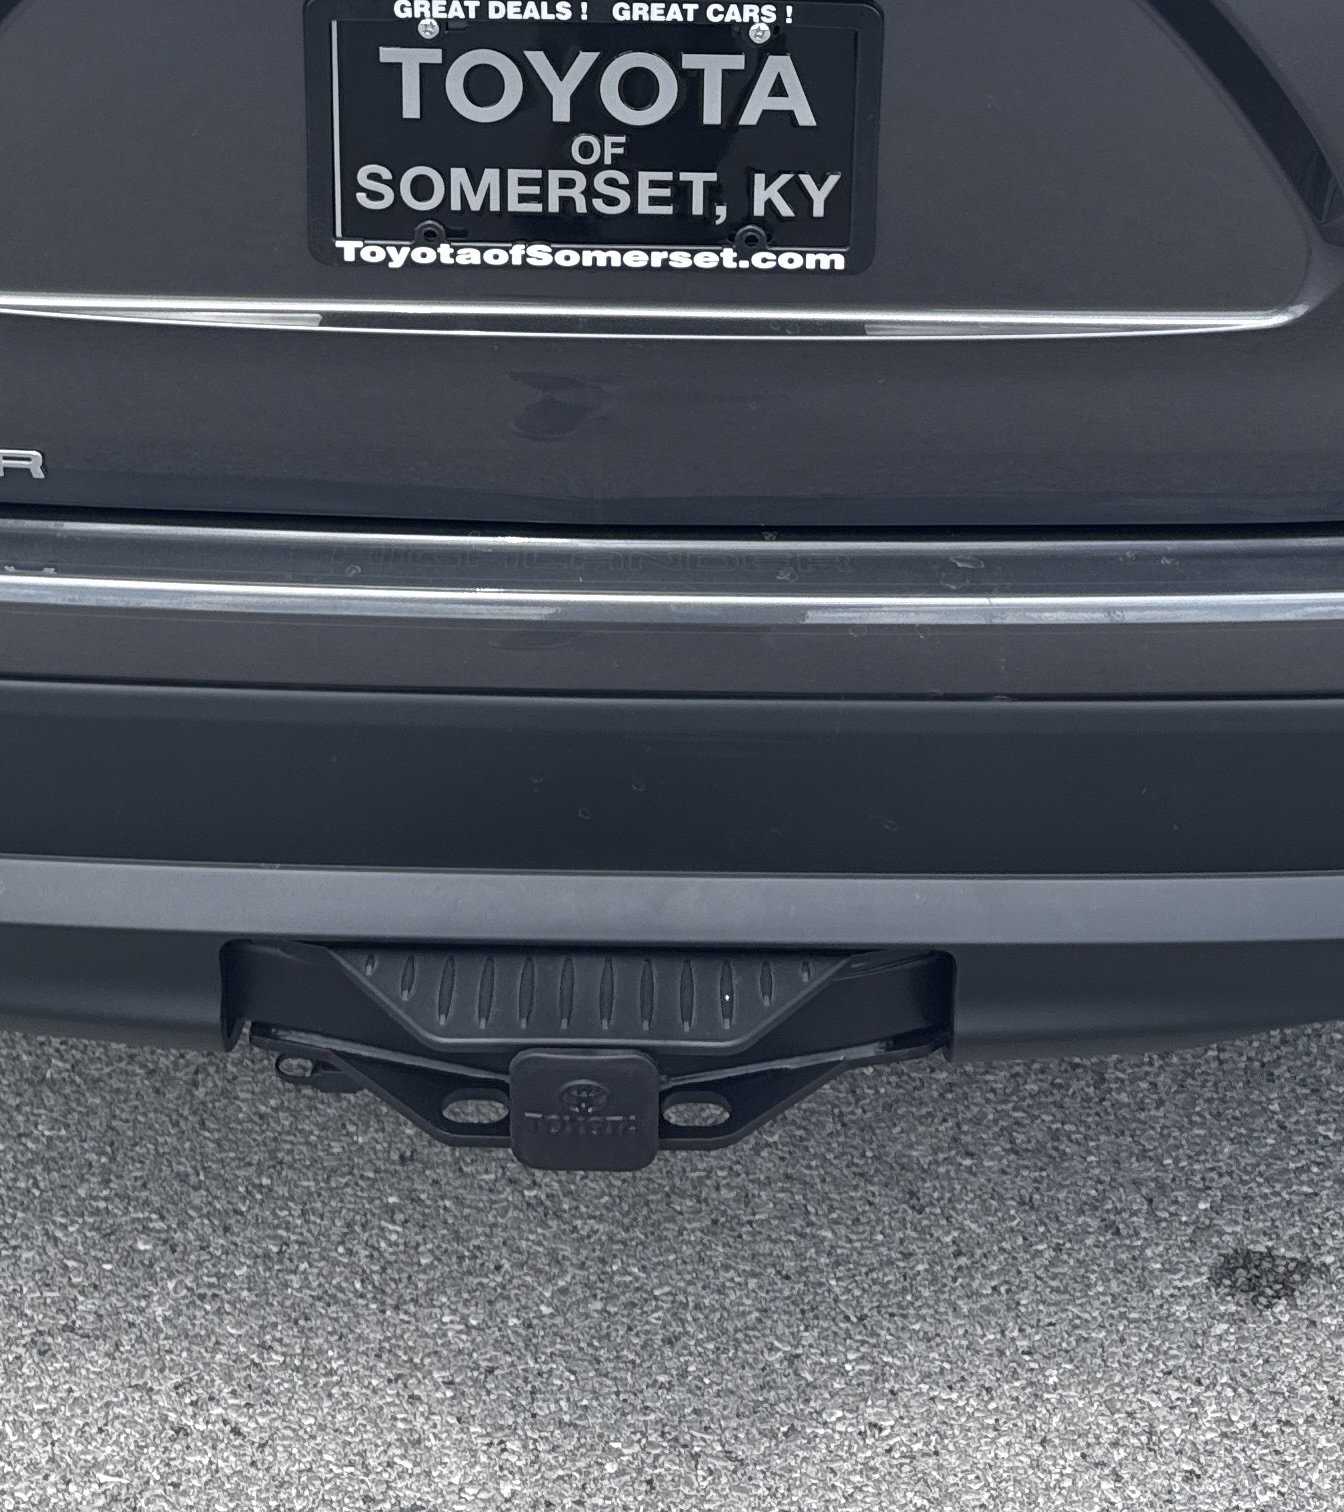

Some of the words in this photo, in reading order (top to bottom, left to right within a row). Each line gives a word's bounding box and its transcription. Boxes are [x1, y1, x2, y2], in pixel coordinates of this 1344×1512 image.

[393, 0, 481, 19] GREAT
[612, 2, 699, 22] GREAT
[378, 46, 818, 127] TOYOTA
[571, 134, 626, 165] OF
[355, 164, 727, 225] SOMERSET,
[753, 172, 842, 217] KY
[335, 240, 845, 270] ToyotaofSomerset.com
